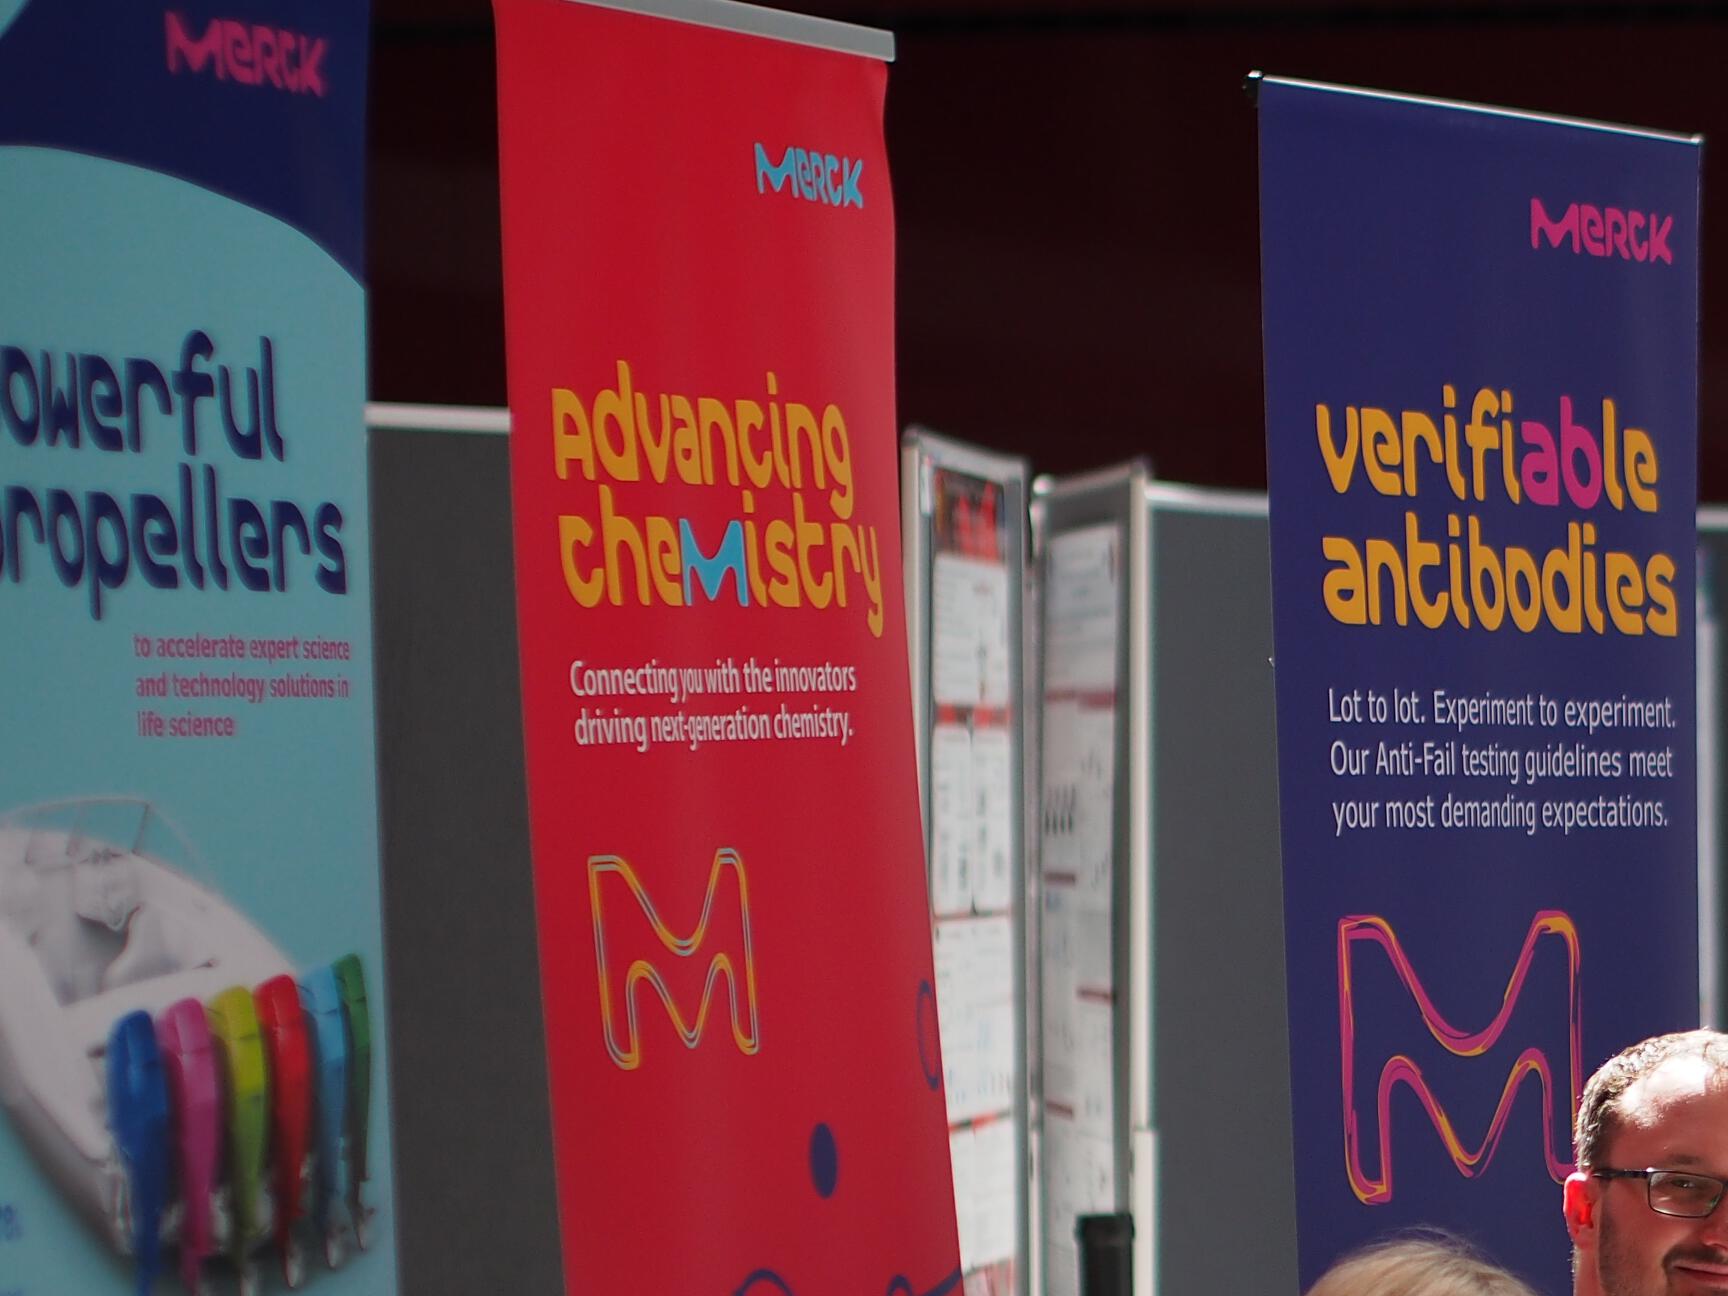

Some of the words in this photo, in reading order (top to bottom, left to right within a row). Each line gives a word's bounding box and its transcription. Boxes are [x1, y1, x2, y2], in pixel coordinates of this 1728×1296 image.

[551, 360, 856, 520] Advancing
[1316, 384, 1658, 513] verifiable
[0, 462, 348, 621] ropellers
[1322, 510, 1678, 637] antibodies
[134, 632, 152, 659] to
[156, 632, 246, 660] accelerate
[250, 635, 299, 664] expert
[302, 635, 351, 661] science
[135, 671, 167, 698] and
[173, 671, 266, 704] technology
[270, 673, 335, 698] solutions
[337, 674, 349, 698] in
[570, 657, 678, 704] Connecting
[679, 668, 703, 704] you
[704, 657, 740, 693] with
[742, 656, 773, 692] the
[774, 657, 857, 692] innovators
[137, 710, 164, 737] life
[168, 710, 236, 738] science
[574, 706, 649, 753] driving
[651, 704, 771, 751] next-generation
[773, 702, 855, 747] chemistry.
[1328, 687, 1362, 724] Lot
[1367, 689, 1388, 724] to
[1393, 687, 1426, 725] lot.
[1433, 689, 1536, 733] Experiment
[1539, 693, 1558, 728] to
[1563, 694, 1677, 736] experiment.
[1330, 740, 1370, 777] Our
[1375, 740, 1456, 778] Anti-Fail
[1461, 743, 1520, 786] testing
[1525, 743, 1622, 786] guidelines
[1628, 746, 1674, 778] meet
[1332, 800, 1380, 838] your
[1385, 797, 1436, 829] most
[1440, 793, 1537, 837] demanding
[1541, 795, 1669, 836] expectations.
